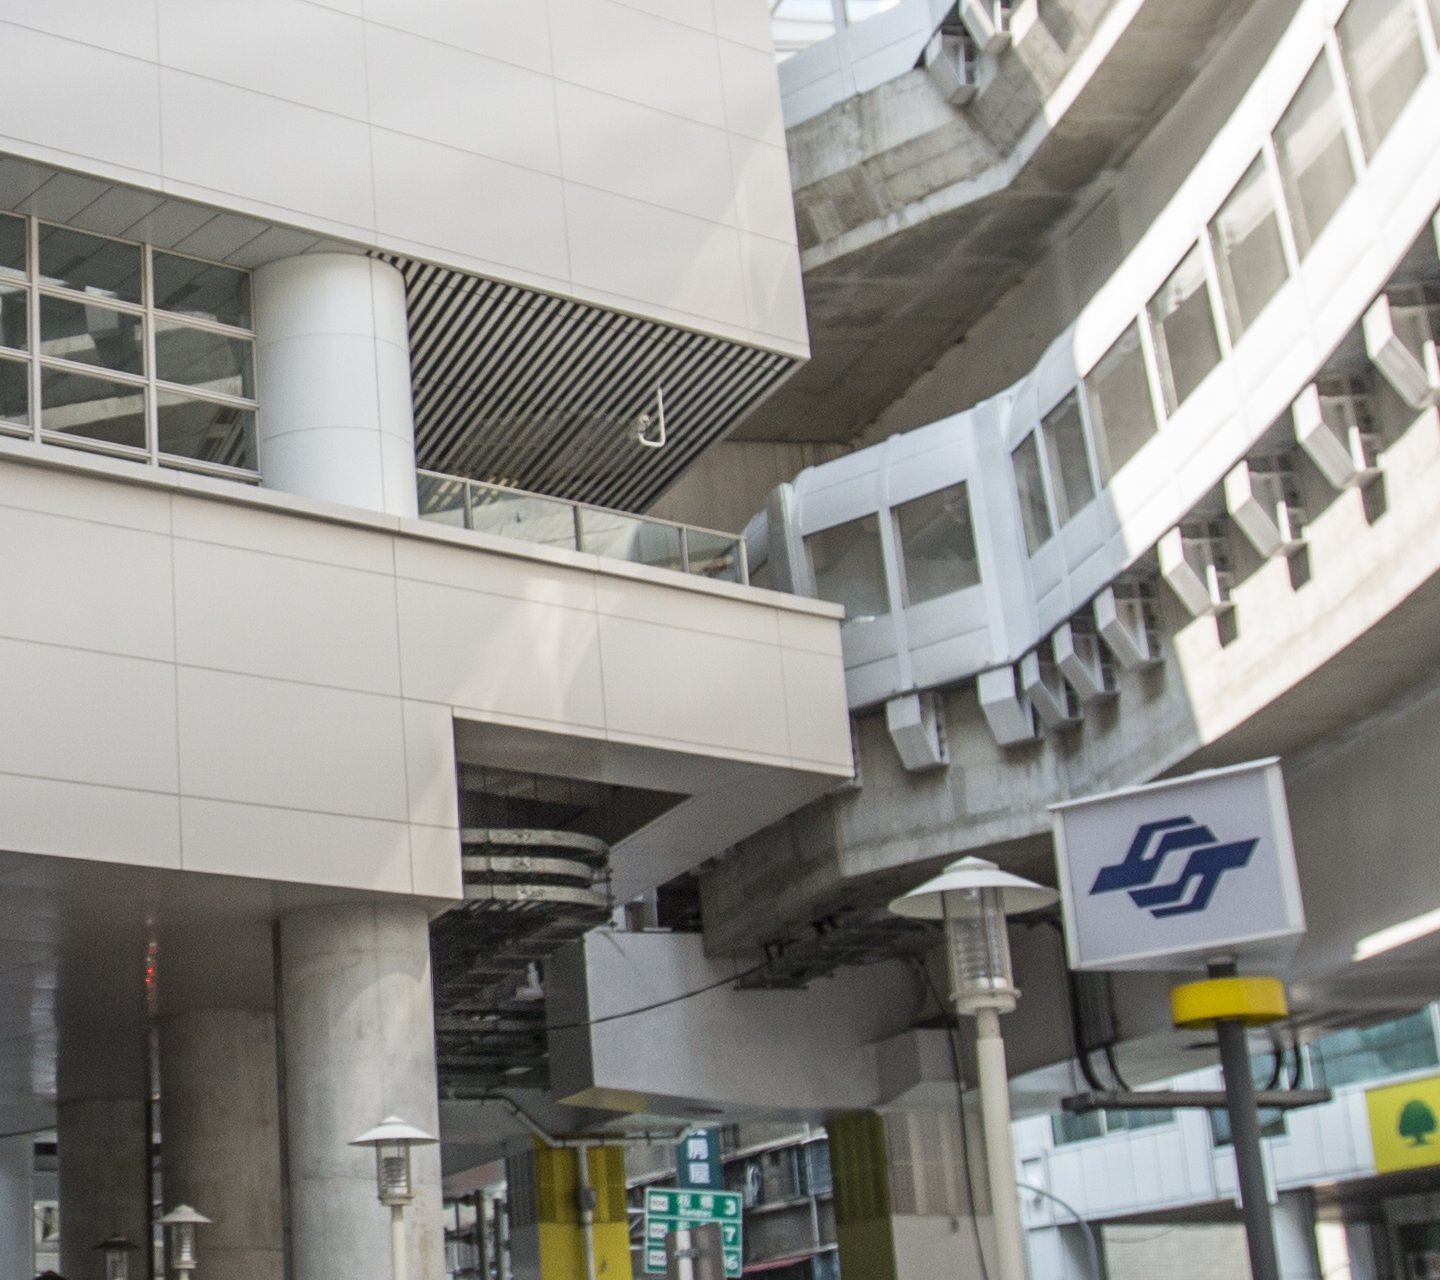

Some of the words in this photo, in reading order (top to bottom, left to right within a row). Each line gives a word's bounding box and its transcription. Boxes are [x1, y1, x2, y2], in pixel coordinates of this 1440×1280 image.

[687, 1129, 711, 1184] 房屋
[724, 1199, 737, 1215] 3
[724, 1226, 737, 1242] 7
